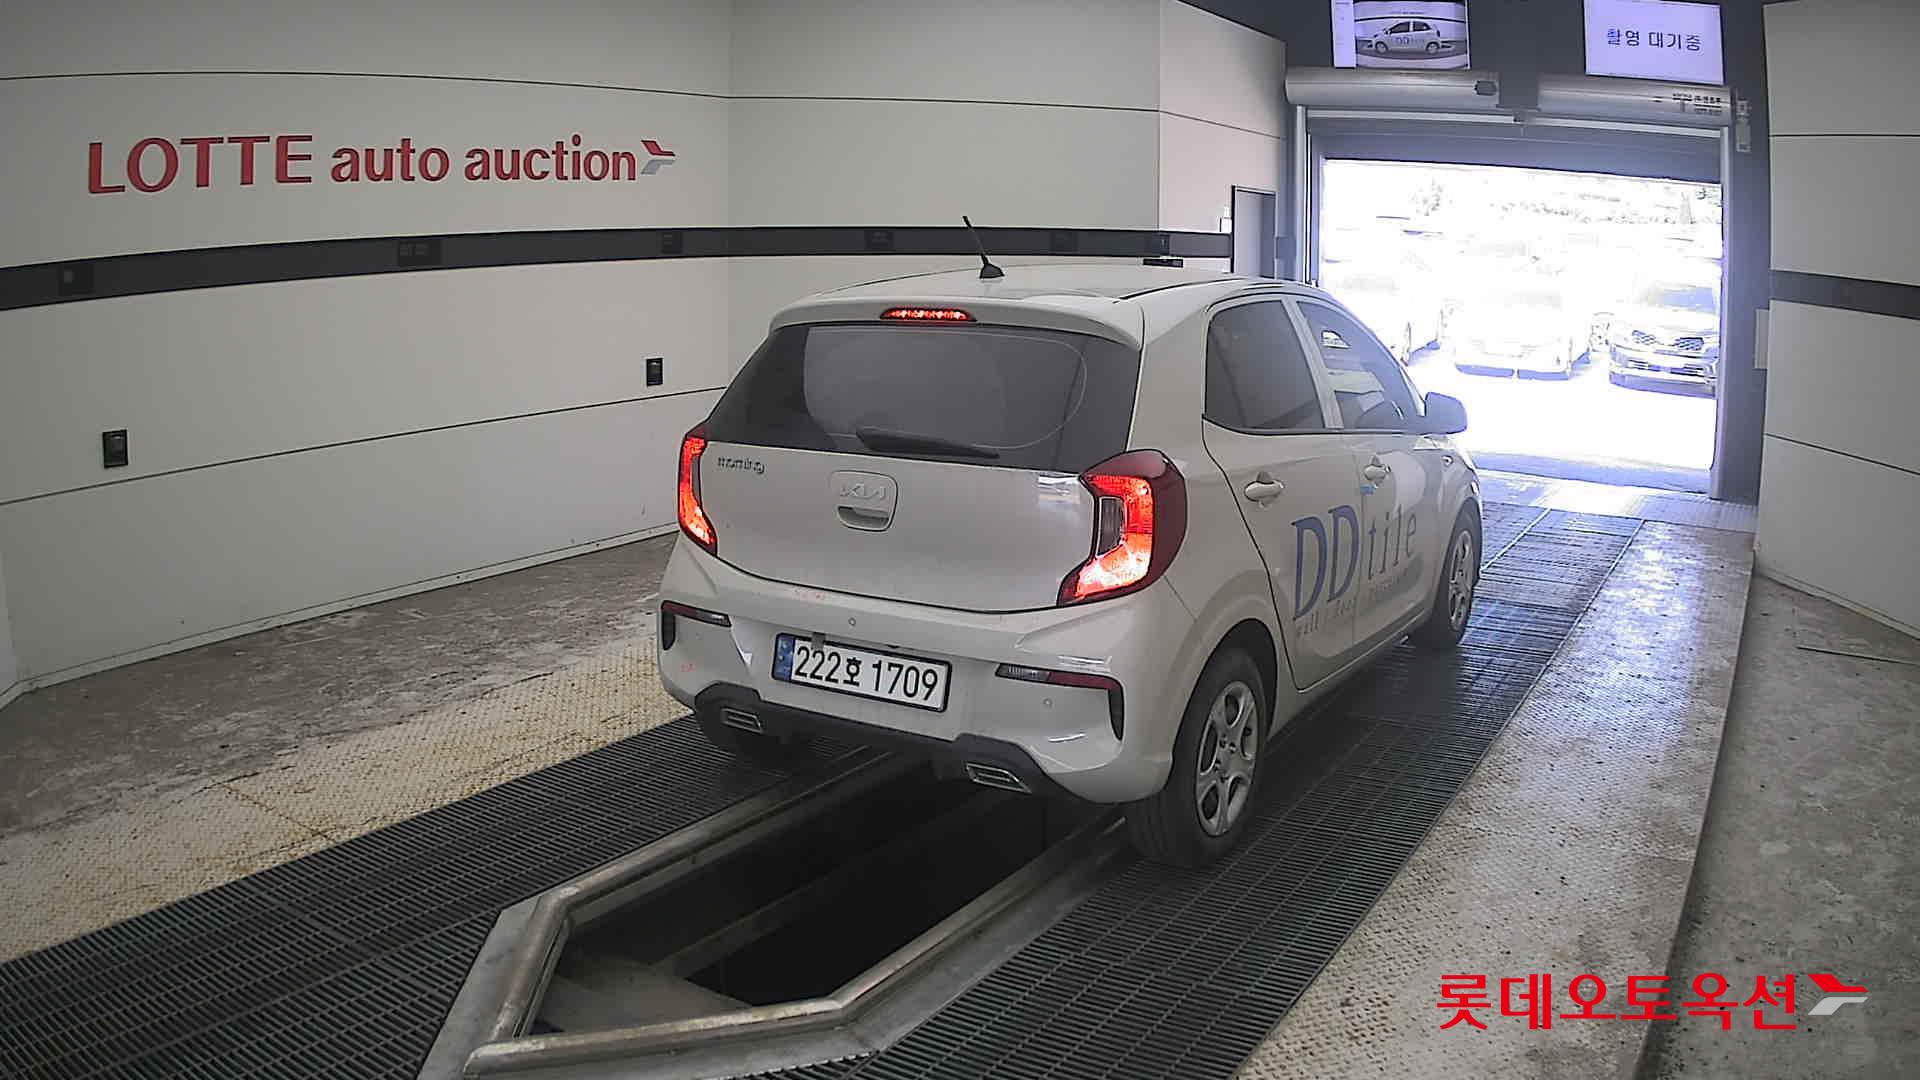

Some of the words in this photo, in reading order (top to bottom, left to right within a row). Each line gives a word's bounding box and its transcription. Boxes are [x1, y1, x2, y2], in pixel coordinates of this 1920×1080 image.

[1648, 31, 1702, 52] 대기중
[88, 134, 313, 195] LOTTE
[331, 138, 450, 182] auto
[464, 133, 637, 182] auction
[794, 645, 862, 687] 222호
[872, 659, 938, 701] 1709
